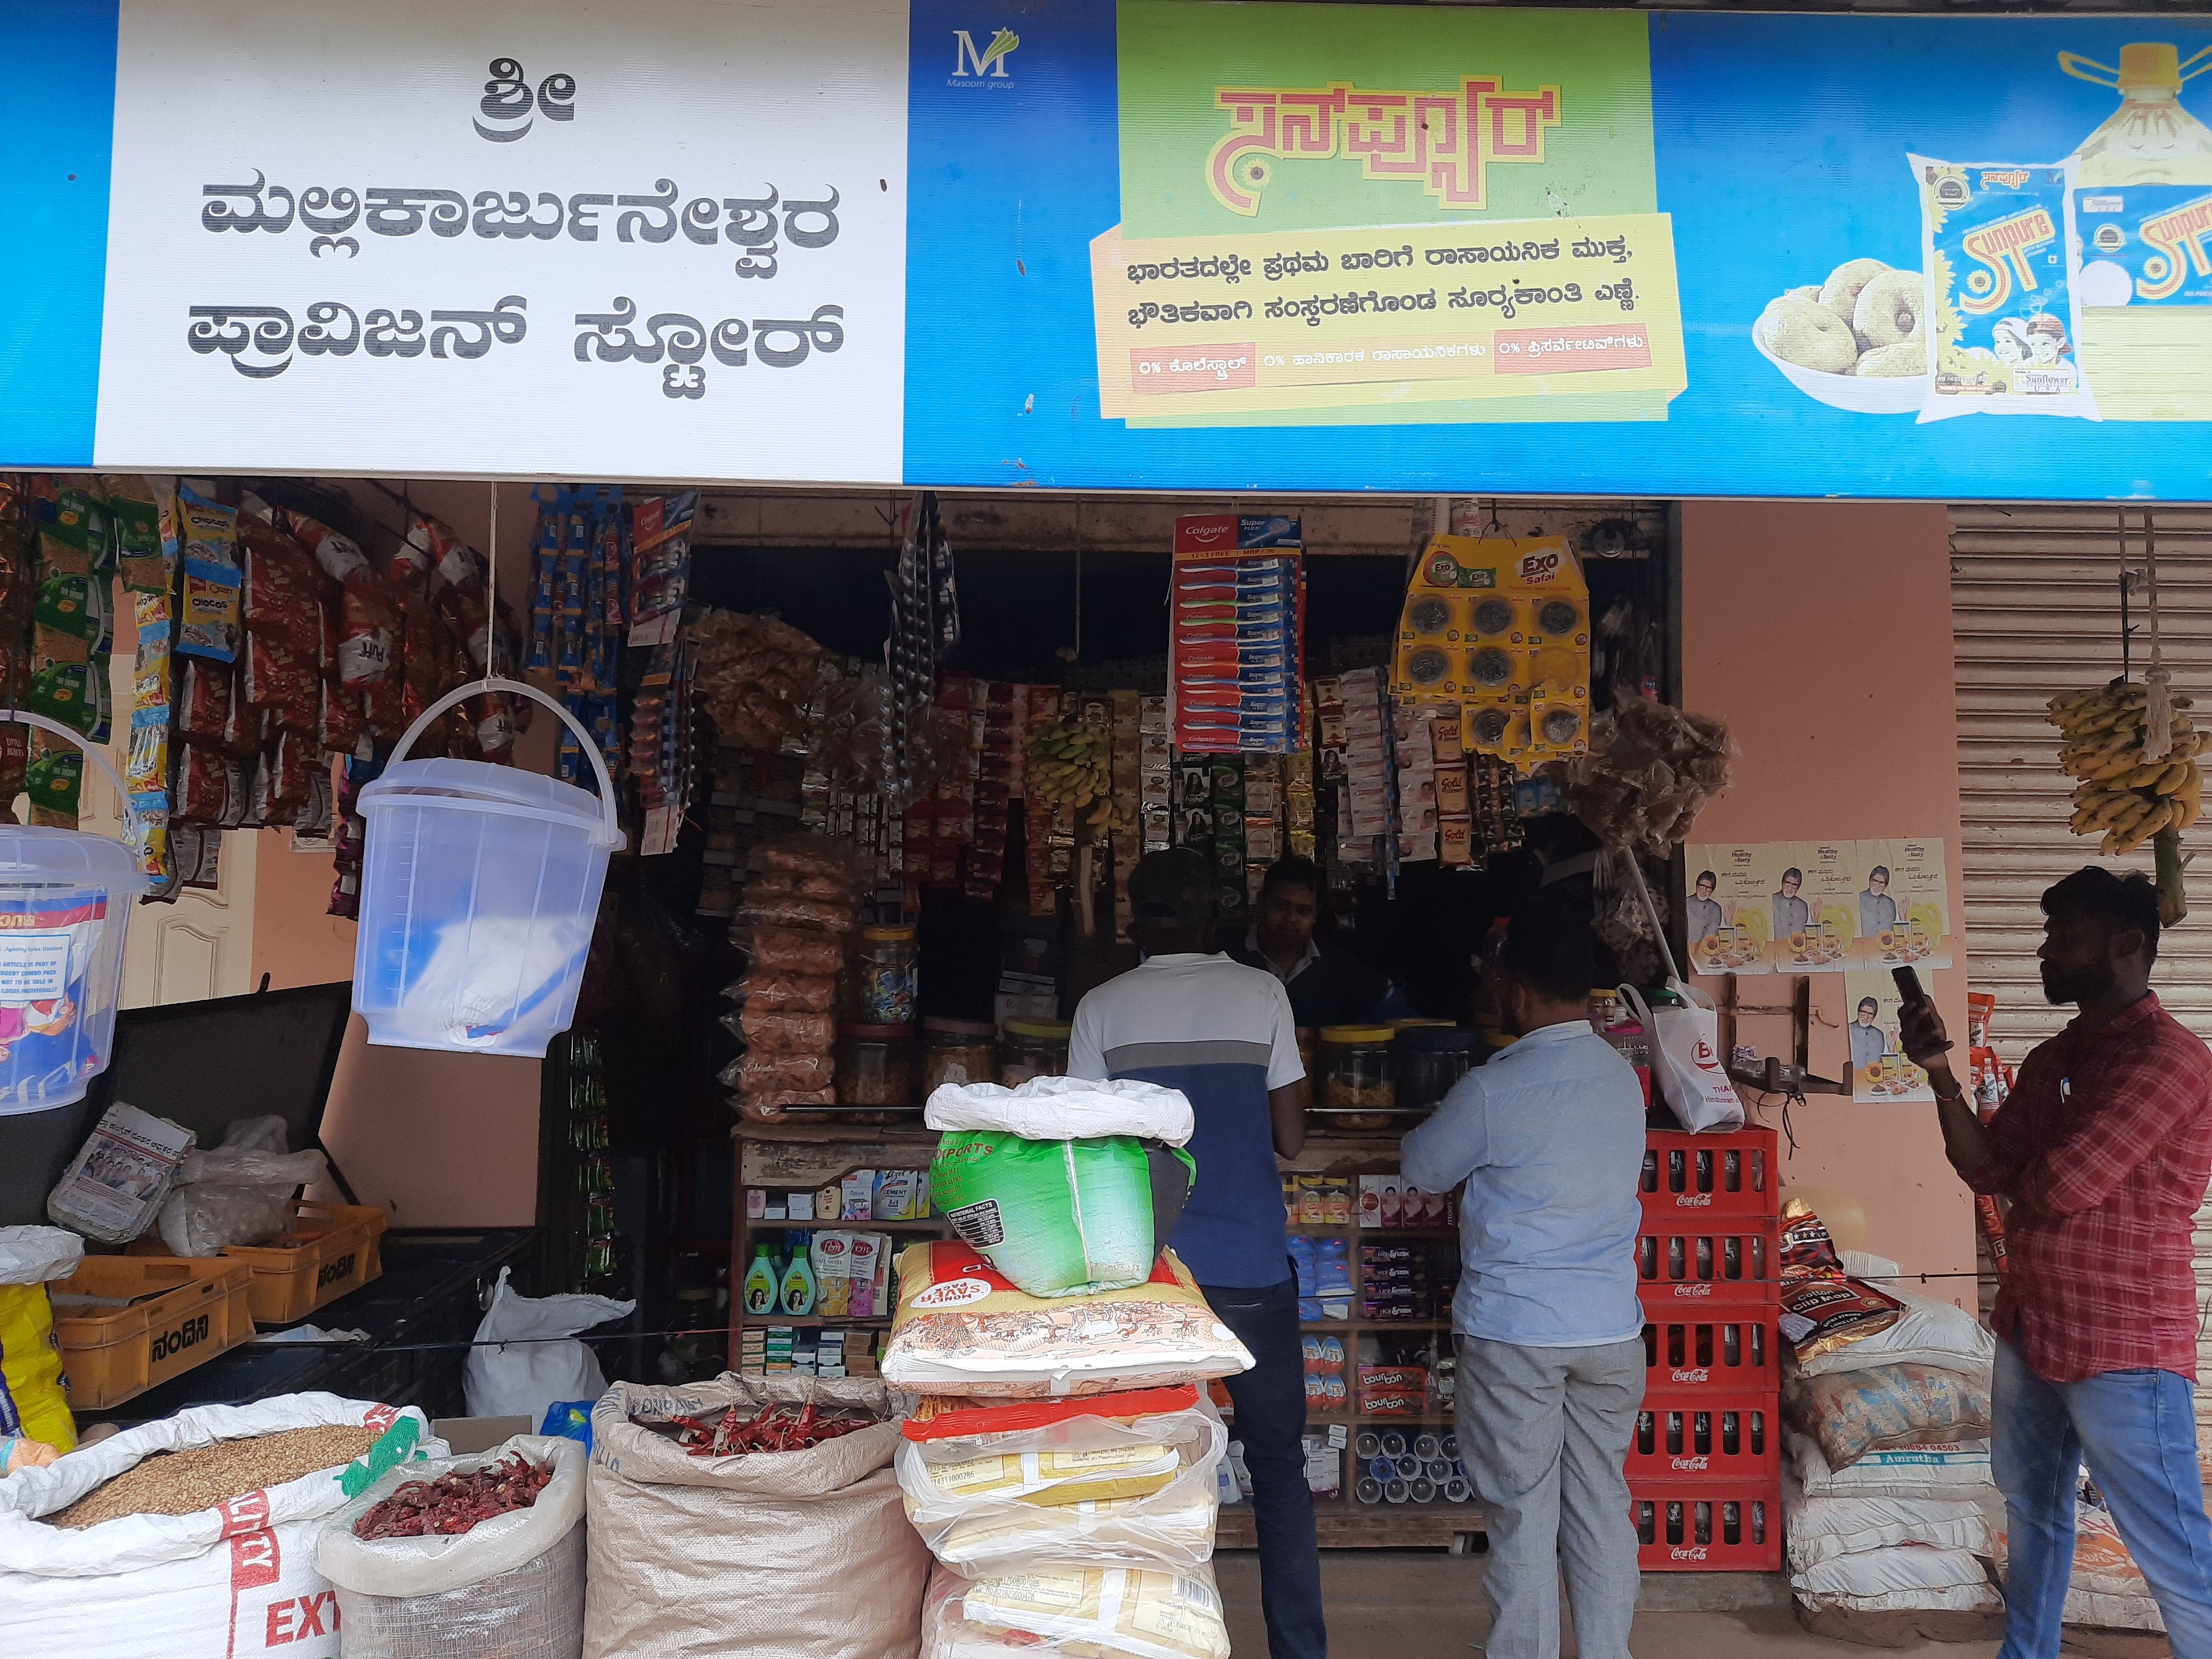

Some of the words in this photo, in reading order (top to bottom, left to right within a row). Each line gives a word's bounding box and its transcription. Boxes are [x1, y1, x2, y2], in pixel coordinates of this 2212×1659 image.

[947, 79, 985, 88] Masoom
[987, 81, 1014, 90] group
[472, 58, 576, 143] ಶ್ರೀ
[201, 168, 839, 280] ಮಲ್ಲಿಕಾರ್ಜುನೇಶ್ವರ
[1127, 254, 1252, 284] ಭಾರತದಲ್ಲೇ
[1263, 251, 1329, 281] ಪ್ರಥಮ
[1341, 245, 1413, 270] ಬಾರಿಗೆ
[1425, 237, 1560, 265] ರಾಸಾಯನಿಕ
[1571, 234, 1633, 264] ಮುಕ್ತ,
[1128, 300, 1253, 329] ಭೌತಿಕವಾಗಿ
[1264, 288, 1437, 327] ಸಂಸ್ಕರಣೆಗೊಂಡ
[188, 295, 527, 379] ಪ್ರಾವಿಜನ್
[574, 296, 844, 401] ಸ್ಟೋರ್
[1292, 348, 1365, 366] ಹಾನಿಕಾರಕ
[1372, 343, 1485, 362] ರಾಸಾಯನಿಕಗಳು
[1240, 519, 1266, 527] Super
[1185, 525, 1229, 536] Colgate
[1526, 572, 1555, 585] Safai
[975, 1202, 993, 1212] FACTS
[920, 1285, 981, 1302] SAVER
[935, 1282, 967, 1292] PACK
[930, 1293, 972, 1305] MONEY
[1792, 1298, 1820, 1311] Clip
[1820, 1291, 1851, 1305] Mop
[1797, 1288, 1836, 1302] Cotton
[152, 1314, 208, 1363] ನಂದಿನಿ
[1362, 1372, 1403, 1385] bourbon
[1364, 1397, 1405, 1410] bourbon
[1886, 1454, 1939, 1463] Amrutha
